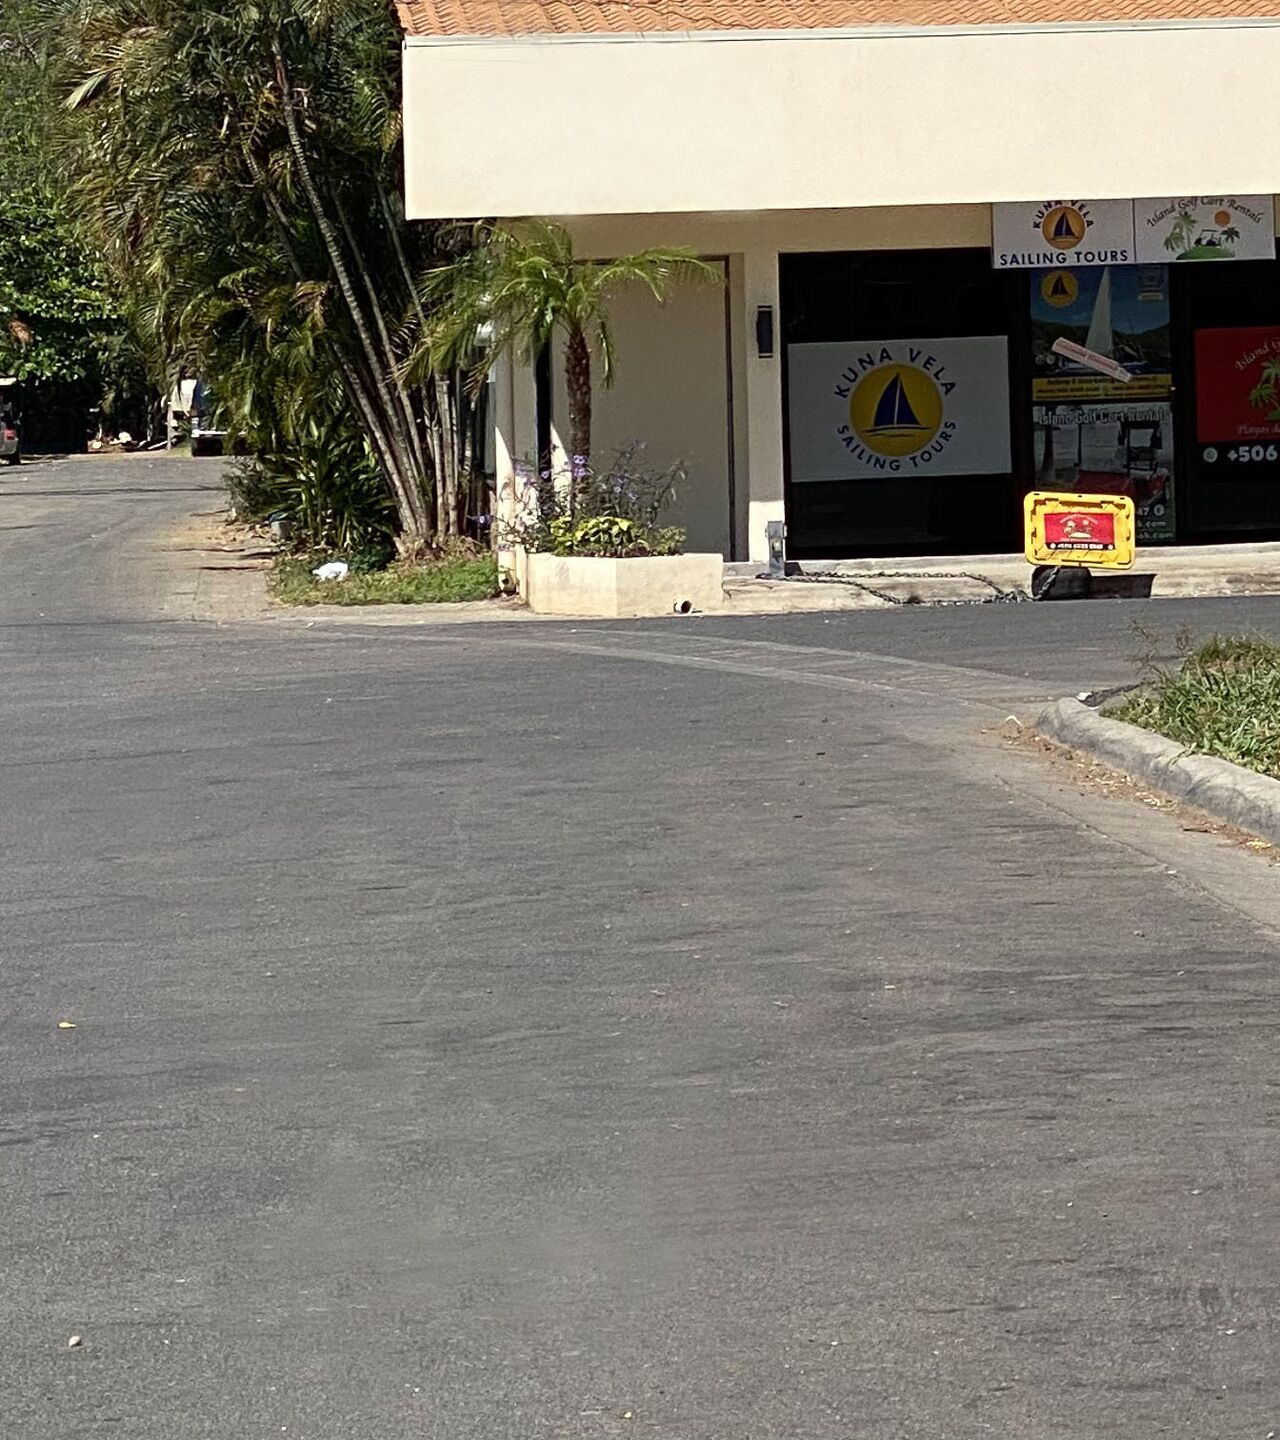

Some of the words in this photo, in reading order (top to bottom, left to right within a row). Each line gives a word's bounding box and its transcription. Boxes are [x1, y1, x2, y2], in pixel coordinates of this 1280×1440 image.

[1033, 200, 1064, 229] KUNA
[1070, 200, 1095, 228] VELA
[1000, 252, 1067, 266] SAILING
[1074, 249, 1129, 264] TOURS
[834, 347, 893, 399] KUNA
[908, 347, 957, 396] VELA
[837, 425, 900, 471] SAILING
[909, 420, 957, 467] TOURS
[1227, 445, 1278, 462] +506
